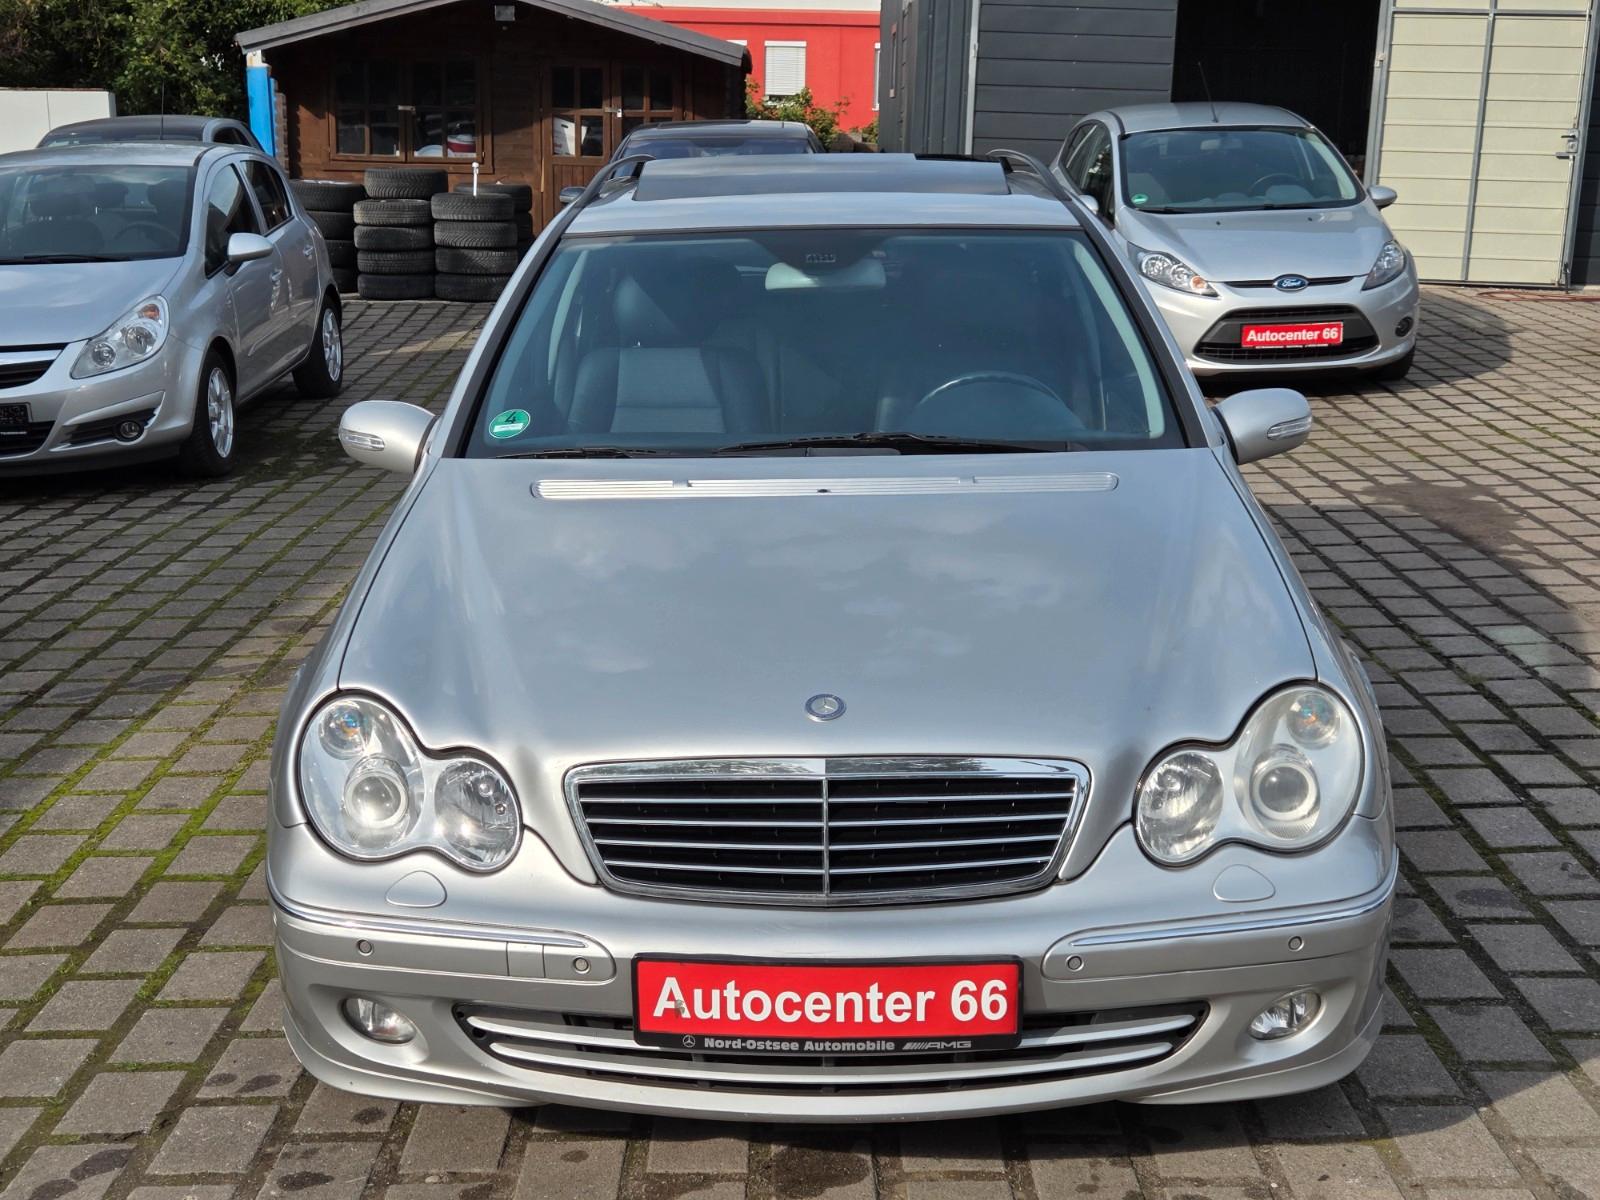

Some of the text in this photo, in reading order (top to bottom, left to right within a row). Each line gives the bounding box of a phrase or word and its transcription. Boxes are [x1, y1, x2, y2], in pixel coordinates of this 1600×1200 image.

[1282, 278, 1301, 287] Ford
[1246, 327, 1338, 342] Autocenter 66
[504, 411, 516, 423] 4
[653, 976, 1008, 1023] Autocenter 66
[704, 1037, 971, 1051] Nord-Ostsee Automobile AMG
